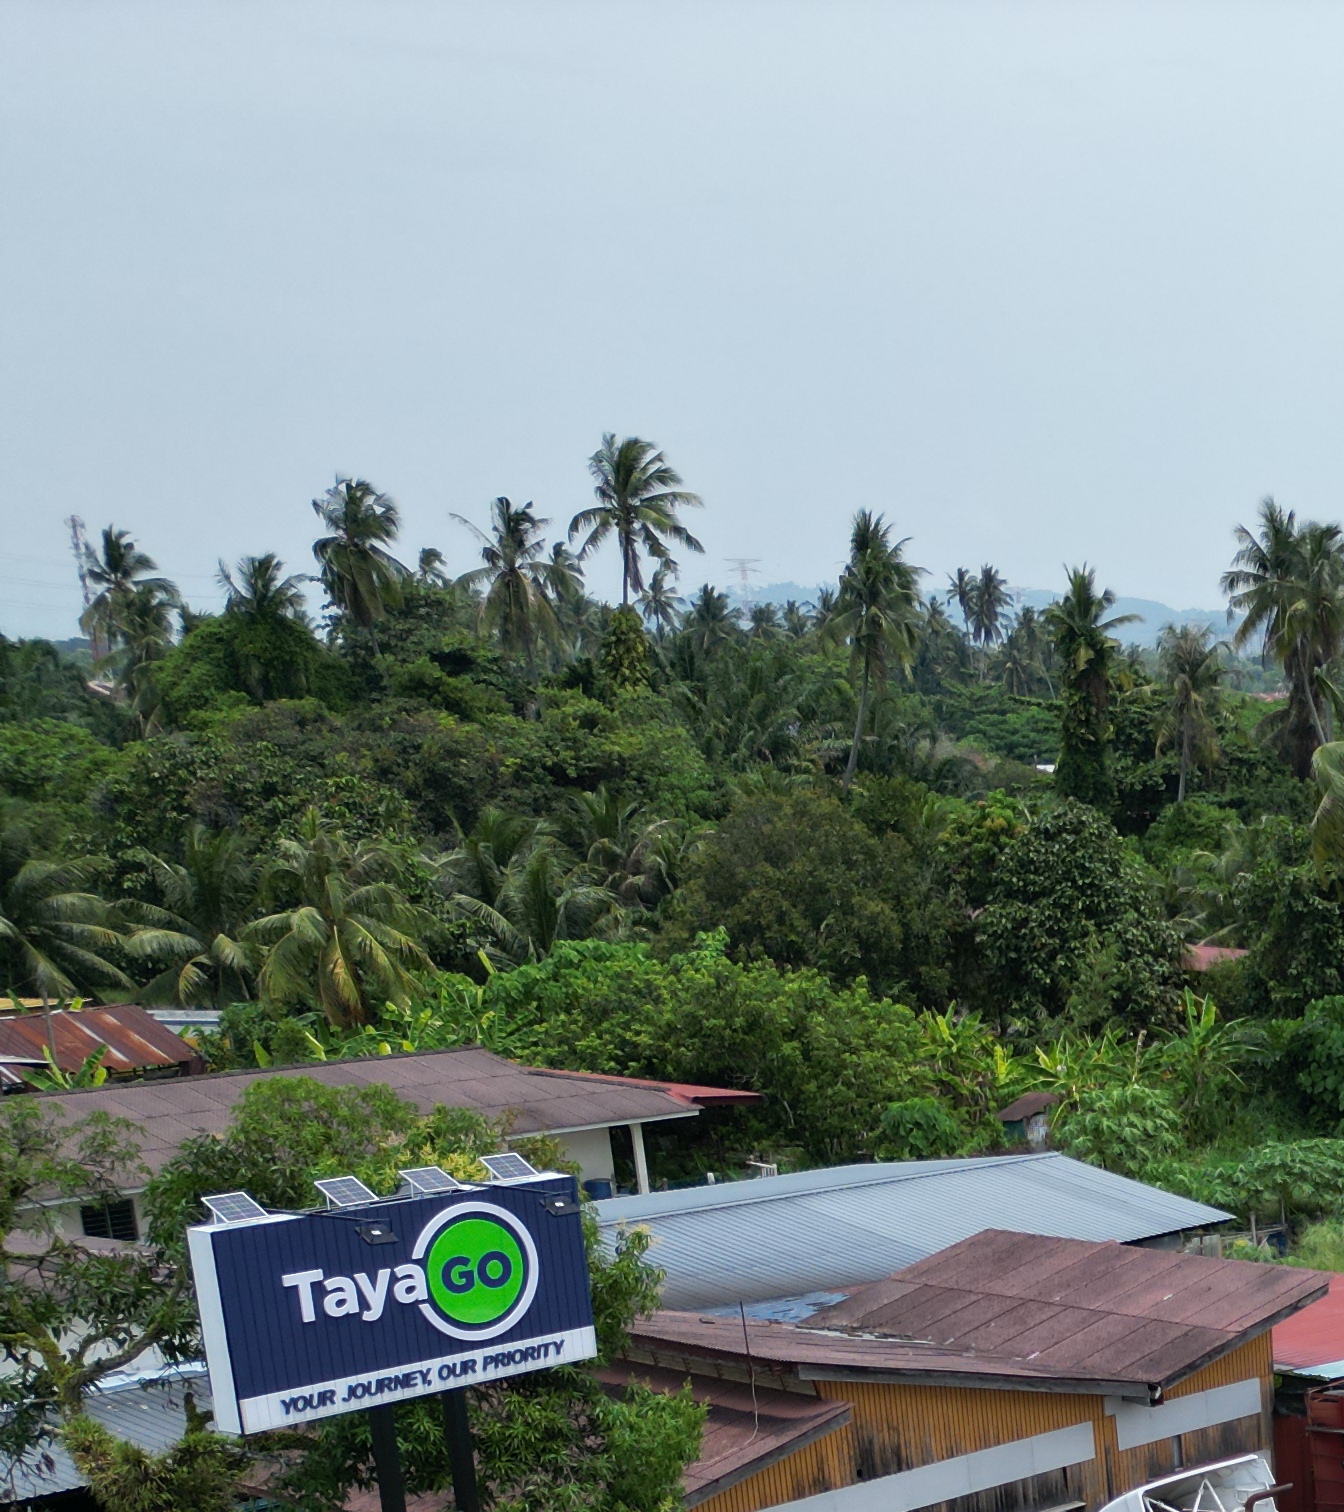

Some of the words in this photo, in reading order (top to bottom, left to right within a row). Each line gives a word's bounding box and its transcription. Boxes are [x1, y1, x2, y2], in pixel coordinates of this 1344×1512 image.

[280, 1389, 336, 1416] YOUR
[341, 1368, 433, 1403] JOURNEY,
[438, 1358, 477, 1381] OUR
[482, 1339, 565, 1372] PRIORITY
